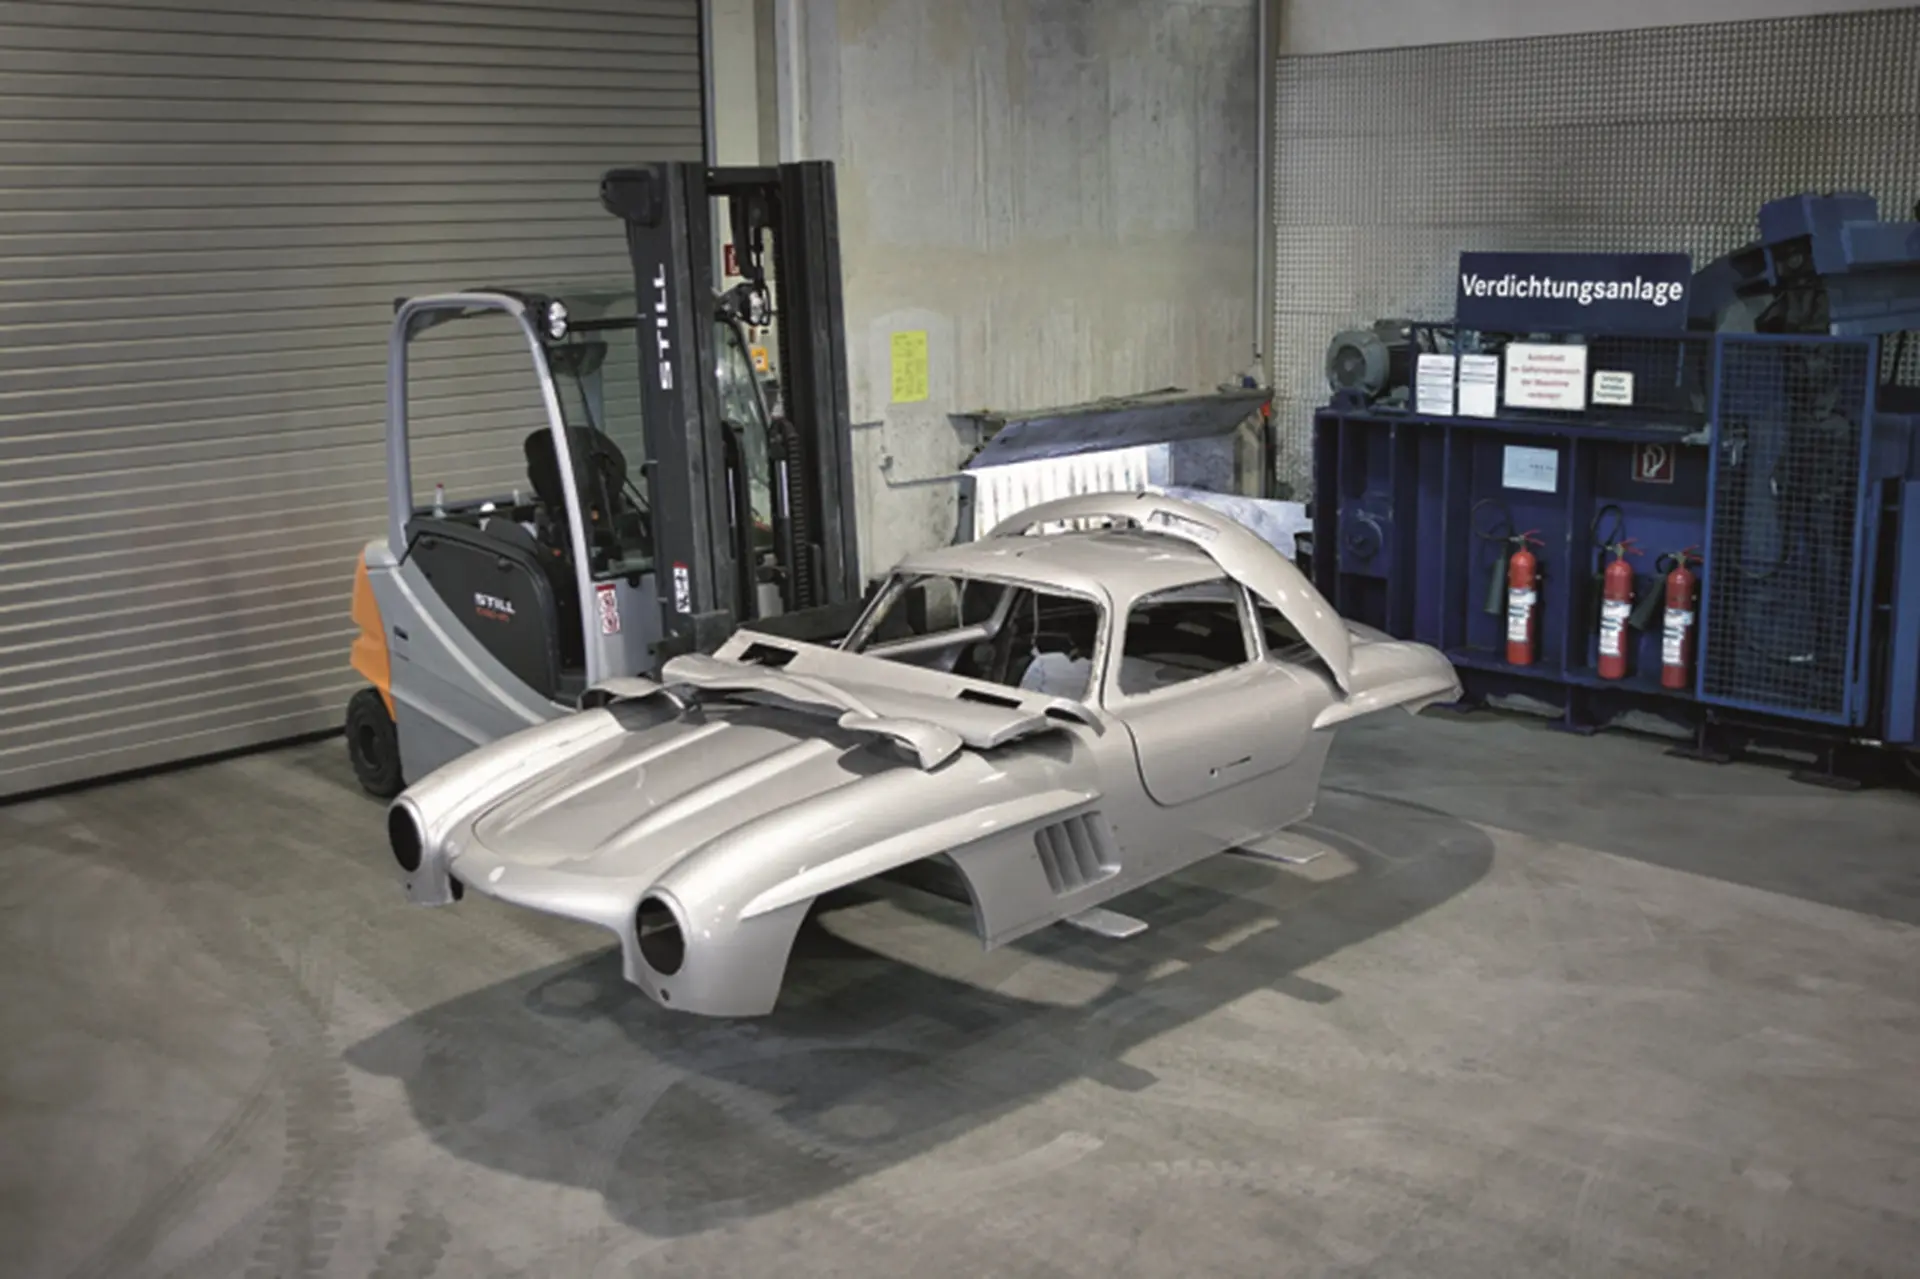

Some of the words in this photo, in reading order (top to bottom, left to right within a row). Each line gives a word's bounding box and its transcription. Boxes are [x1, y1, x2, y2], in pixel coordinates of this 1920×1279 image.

[1462, 273, 1684, 307] Verdichtungsanlage
[653, 263, 673, 390] STILL
[474, 592, 516, 615] STILL
